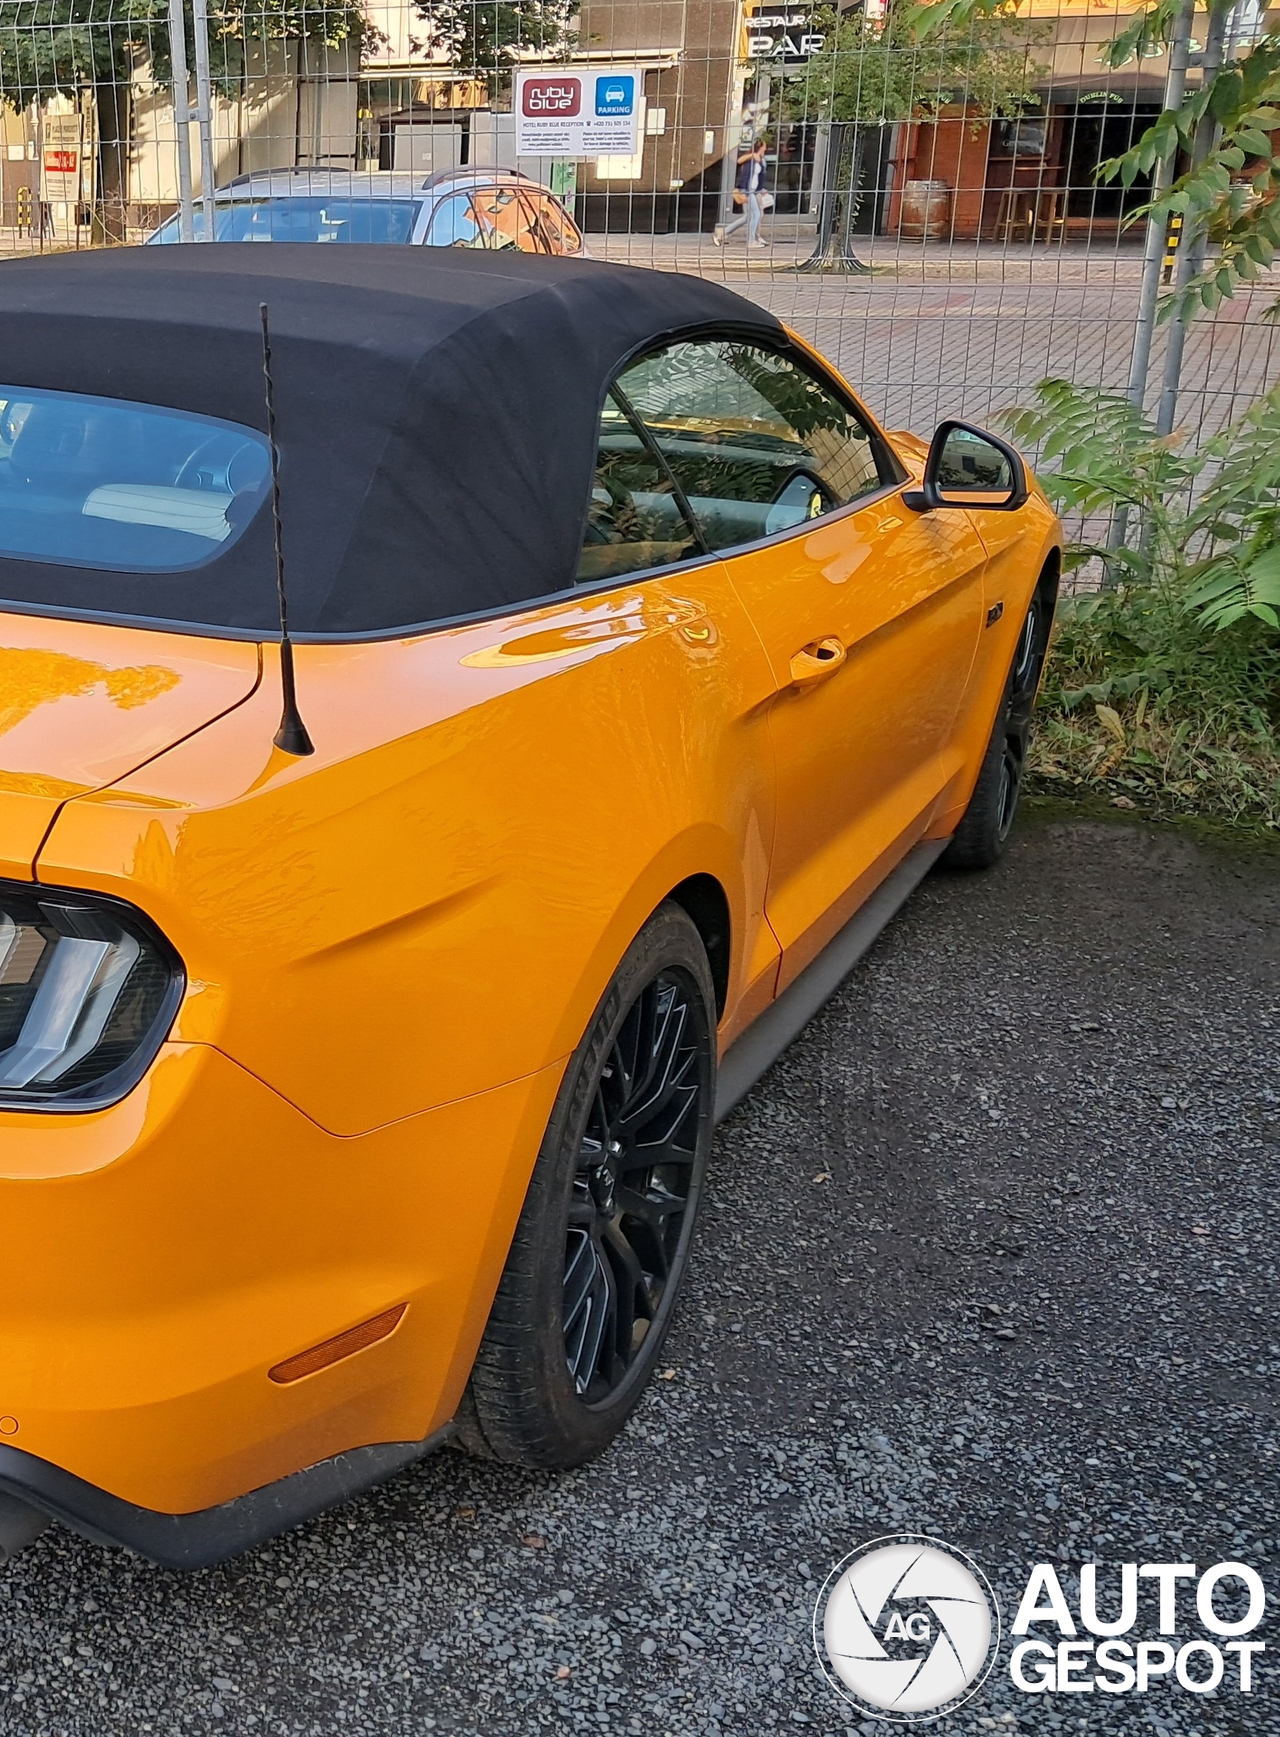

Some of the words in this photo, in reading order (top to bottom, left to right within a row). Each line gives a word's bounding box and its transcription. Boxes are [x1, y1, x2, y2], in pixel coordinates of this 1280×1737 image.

[531, 86, 574, 99] ruby
[1079, 91, 1107, 103] DUBLIN
[1109, 92, 1123, 103] PUB
[529, 98, 571, 109] blue
